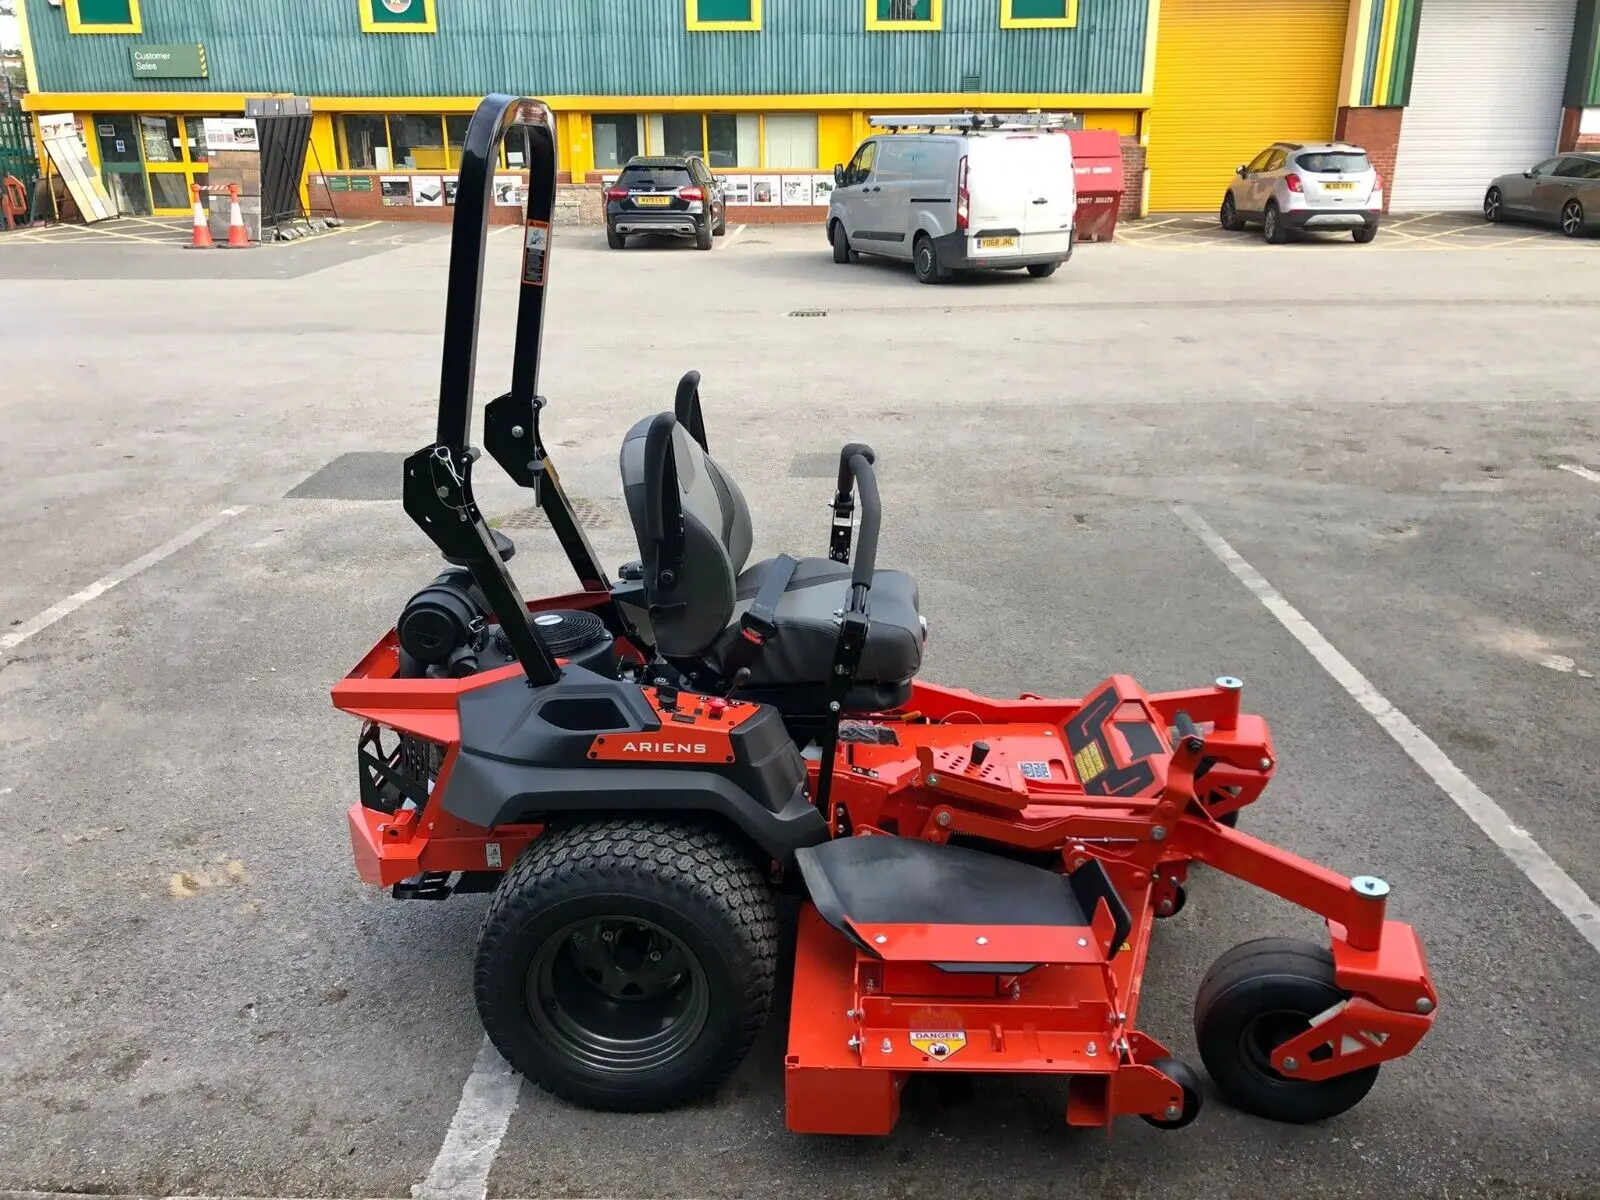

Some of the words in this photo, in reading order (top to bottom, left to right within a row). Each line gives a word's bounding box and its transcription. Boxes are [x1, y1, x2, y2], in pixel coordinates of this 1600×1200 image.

[134, 51, 170, 60] Customer
[136, 62, 158, 71] Sales
[622, 741, 707, 754] ARIENS
